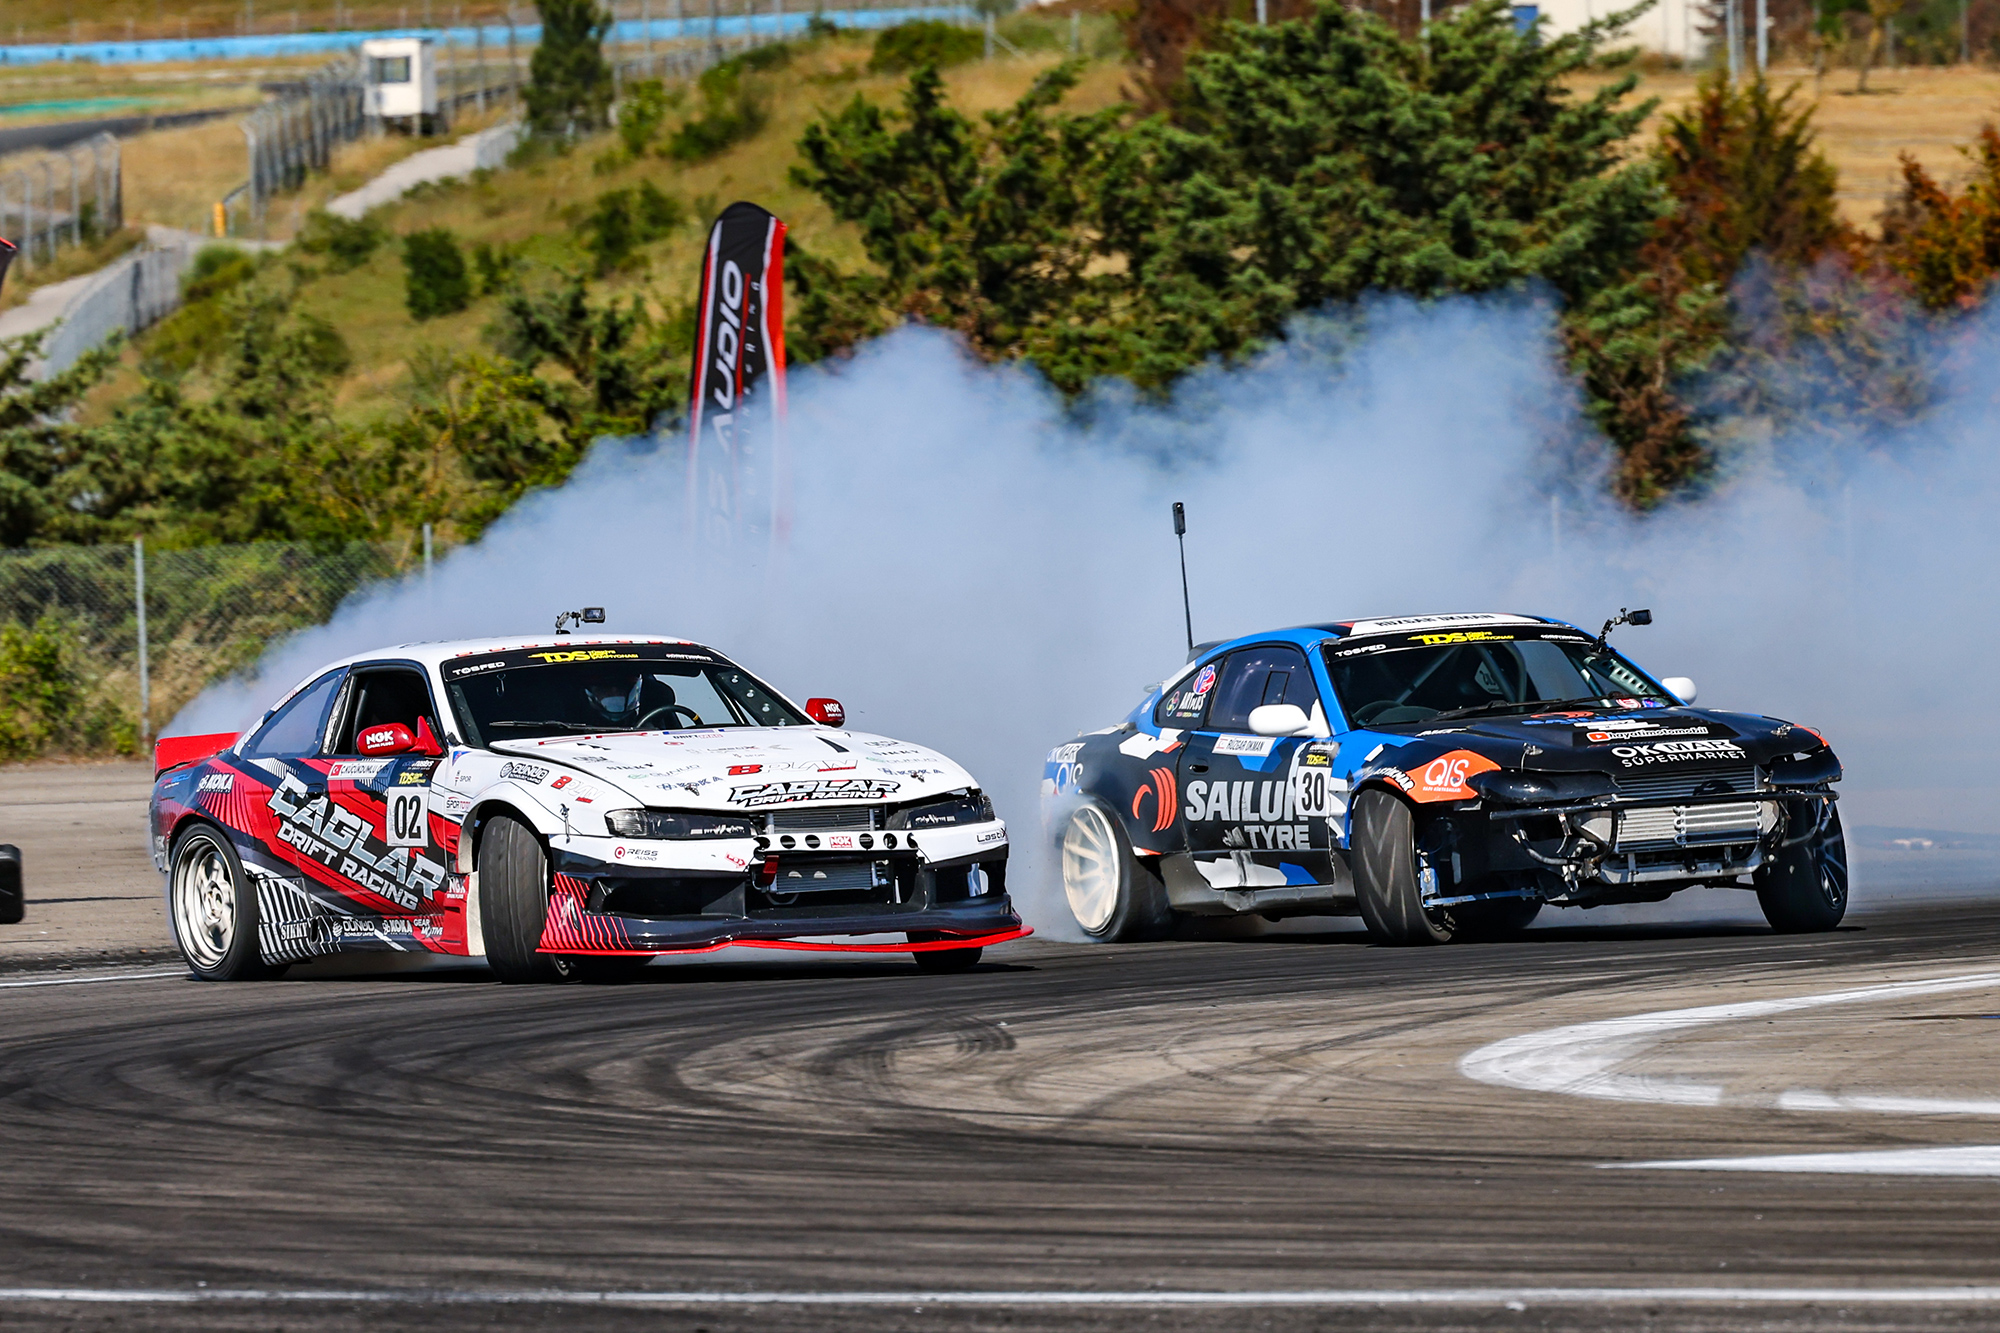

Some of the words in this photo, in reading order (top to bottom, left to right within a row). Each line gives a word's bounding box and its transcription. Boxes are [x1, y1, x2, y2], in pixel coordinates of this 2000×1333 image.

[1335, 643, 1387, 657] TOSFED
[452, 662, 506, 676] TOSFED
[823, 703, 842, 713] NGK
[365, 730, 394, 745] NGK
[1621, 750, 1747, 768] SÜPERMARKET
[1424, 758, 1470, 787] QIS
[748, 792, 807, 806] DRIFT
[1301, 771, 1325, 812] 30
[394, 795, 422, 840] 02
[830, 836, 851, 845] NGK
[1244, 824, 1311, 850] TYRE
[626, 848, 659, 856] REISS
[276, 820, 339, 866] DRIFT
[339, 856, 420, 912] RACING
